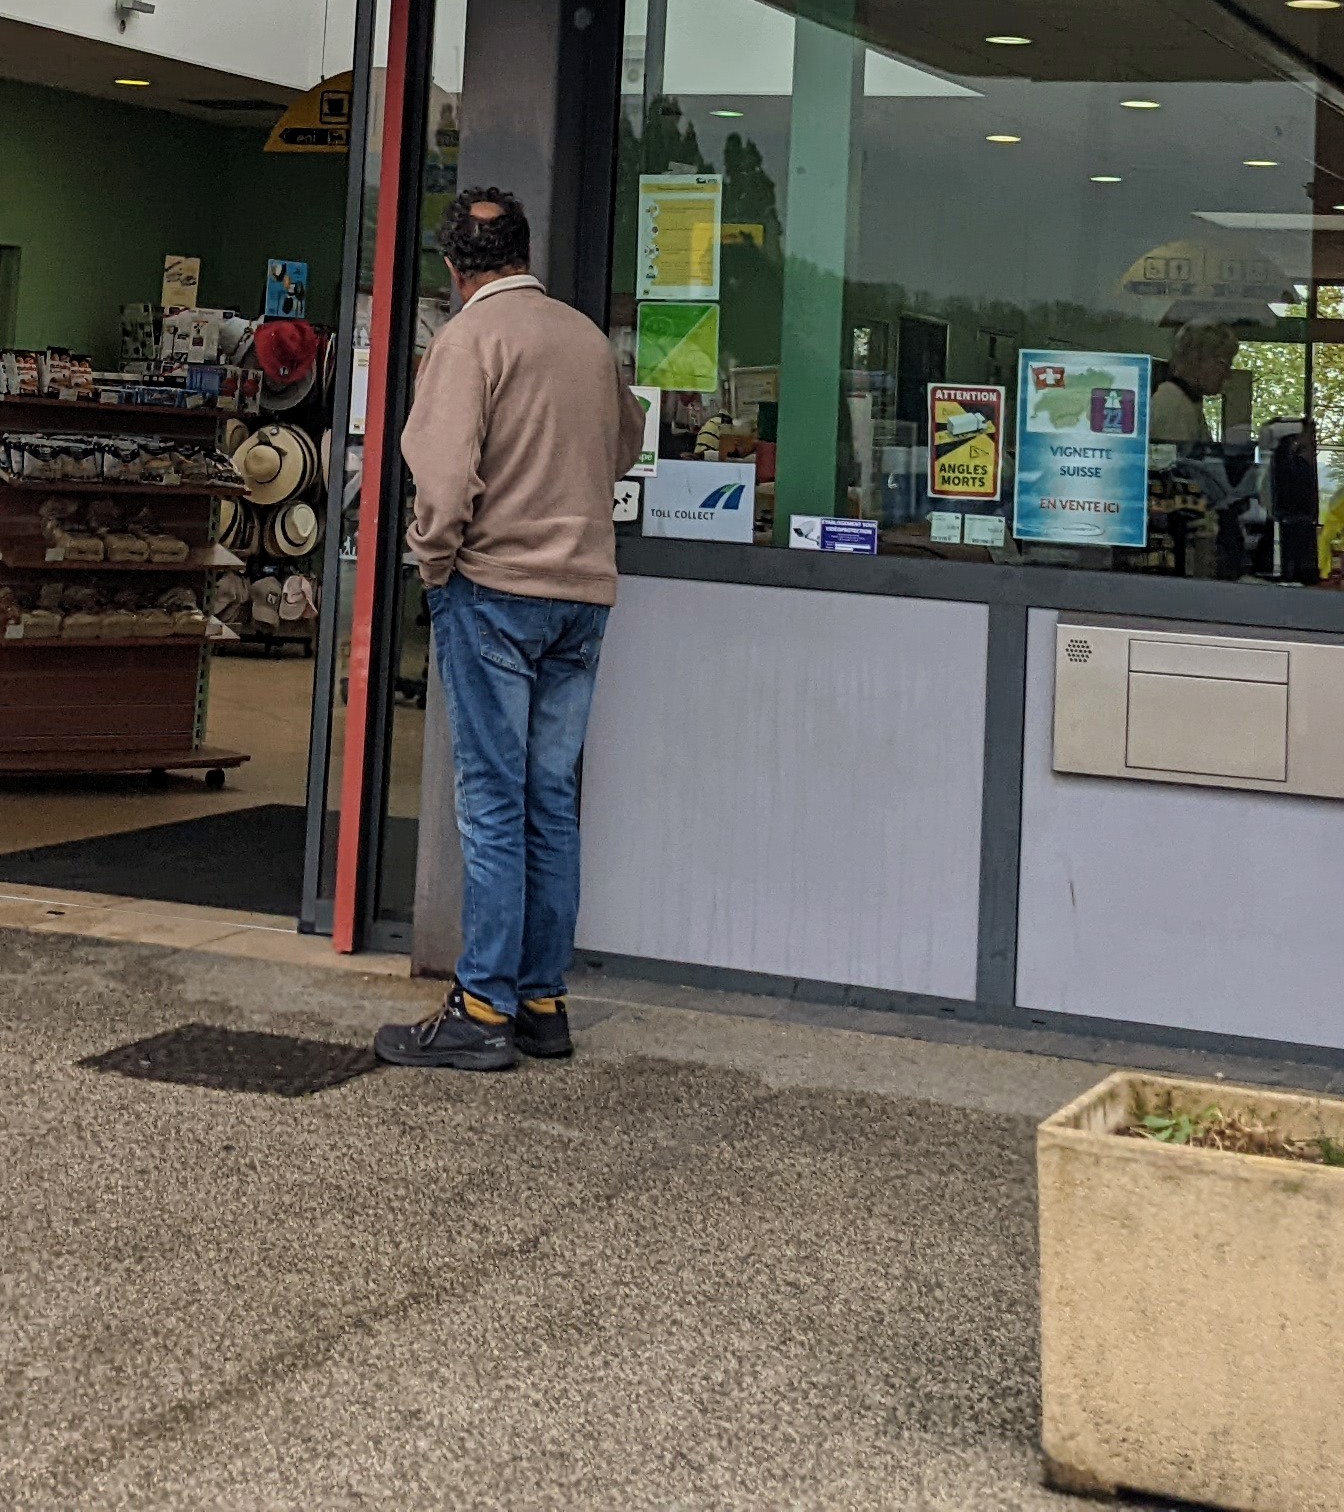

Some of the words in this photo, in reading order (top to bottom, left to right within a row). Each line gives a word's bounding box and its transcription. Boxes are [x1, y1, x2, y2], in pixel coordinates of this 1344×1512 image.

[935, 389, 998, 402] ATTENTION
[1050, 446, 1113, 460] VIGNETTE
[939, 463, 988, 476] ANGLES
[1059, 465, 1103, 478] SUISSE
[941, 475, 986, 488] MORTS
[1040, 497, 1057, 510] EN
[1059, 498, 1101, 513] VENTE
[1103, 501, 1120, 514] ICI
[650, 508, 671, 518] TOLL
[674, 509, 716, 521] COLLECT
